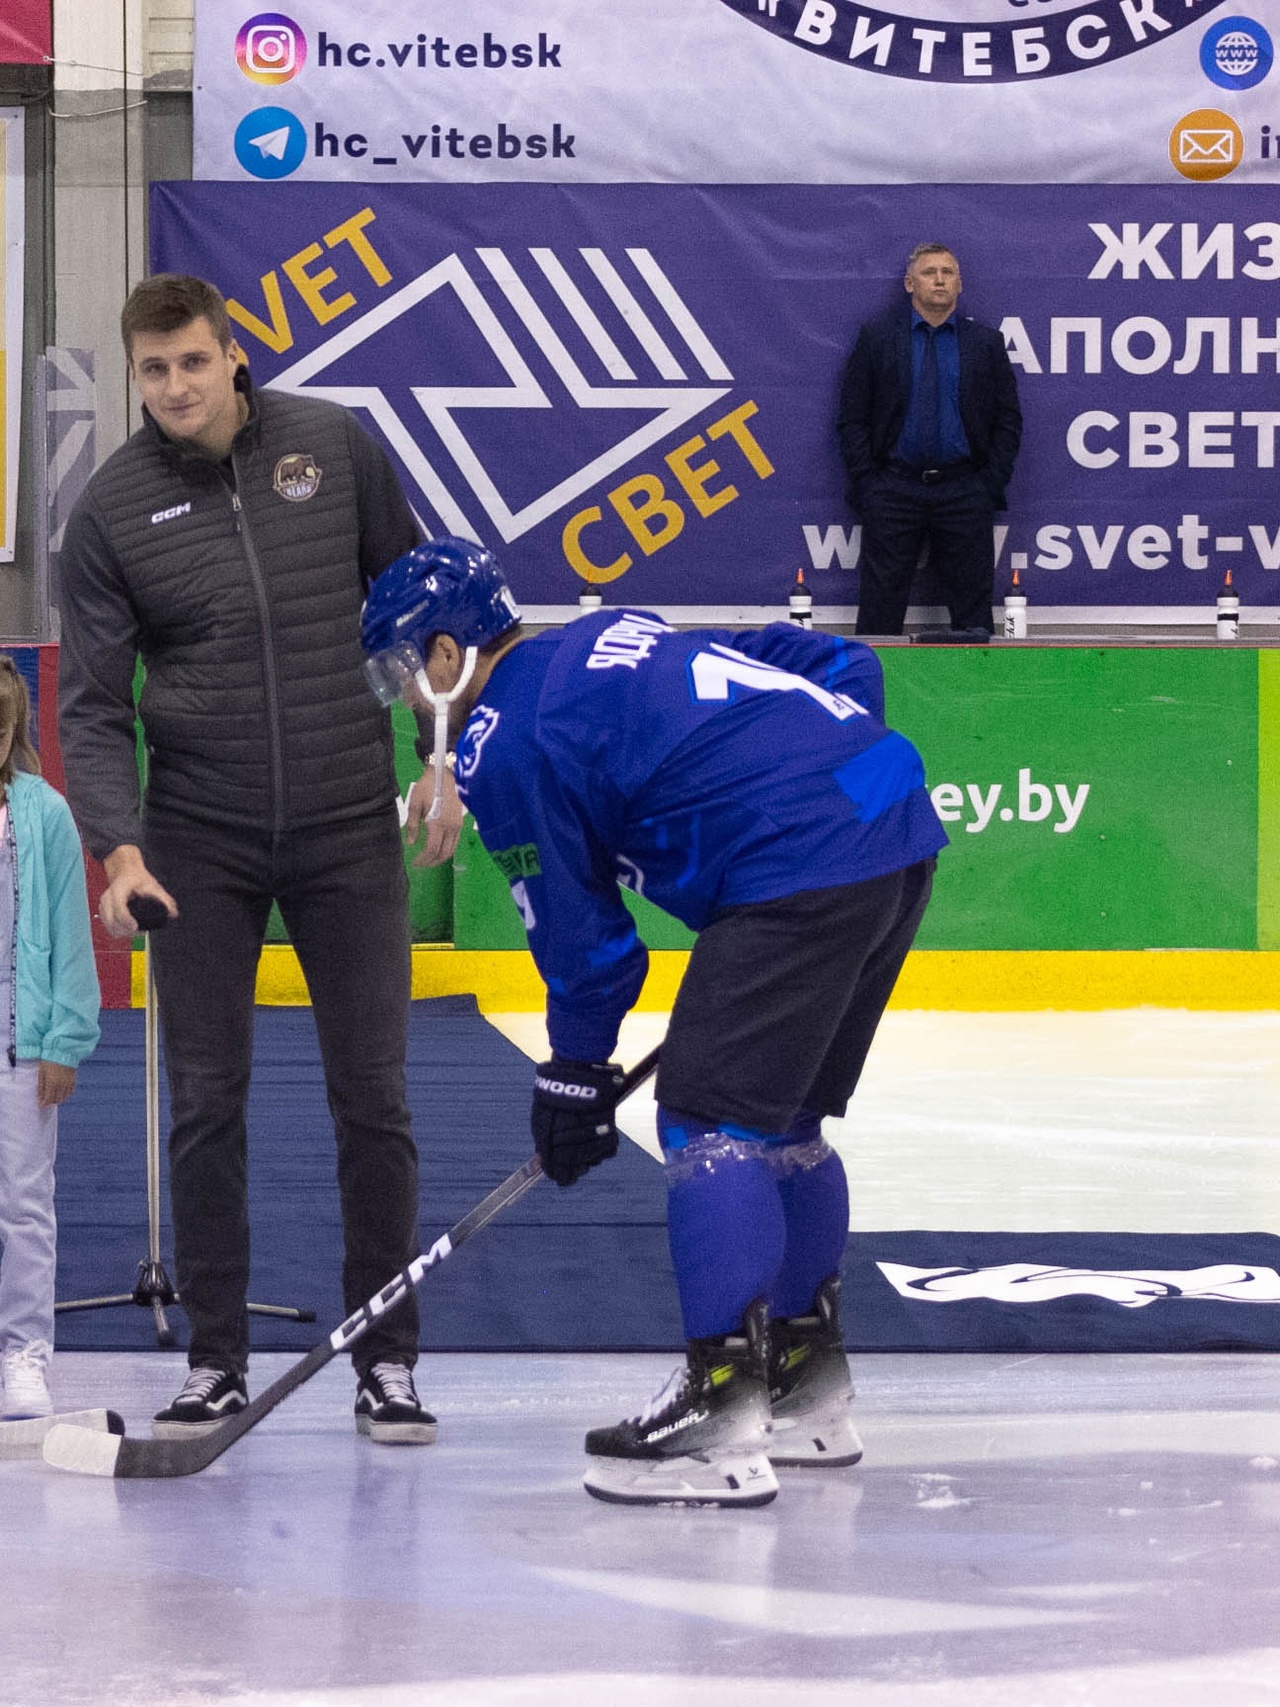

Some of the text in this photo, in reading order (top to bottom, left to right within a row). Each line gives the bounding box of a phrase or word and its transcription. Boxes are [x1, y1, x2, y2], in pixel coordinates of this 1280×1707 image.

[317, 32, 562, 68] hc.vitebsk
[314, 122, 576, 165] hc_vitebsk
[1087, 221, 1280, 281] ЖИЗ
[225, 207, 394, 366] VET
[982, 316, 1280, 375] АПОЛН
[1066, 410, 1280, 469] СВЕТ
[151, 501, 191, 524] CCM
[562, 400, 775, 584] СВЕТ
[925, 767, 1090, 833] ey.by
[535, 1074, 597, 1099] WOOD
[329, 1232, 452, 1350] CCM
